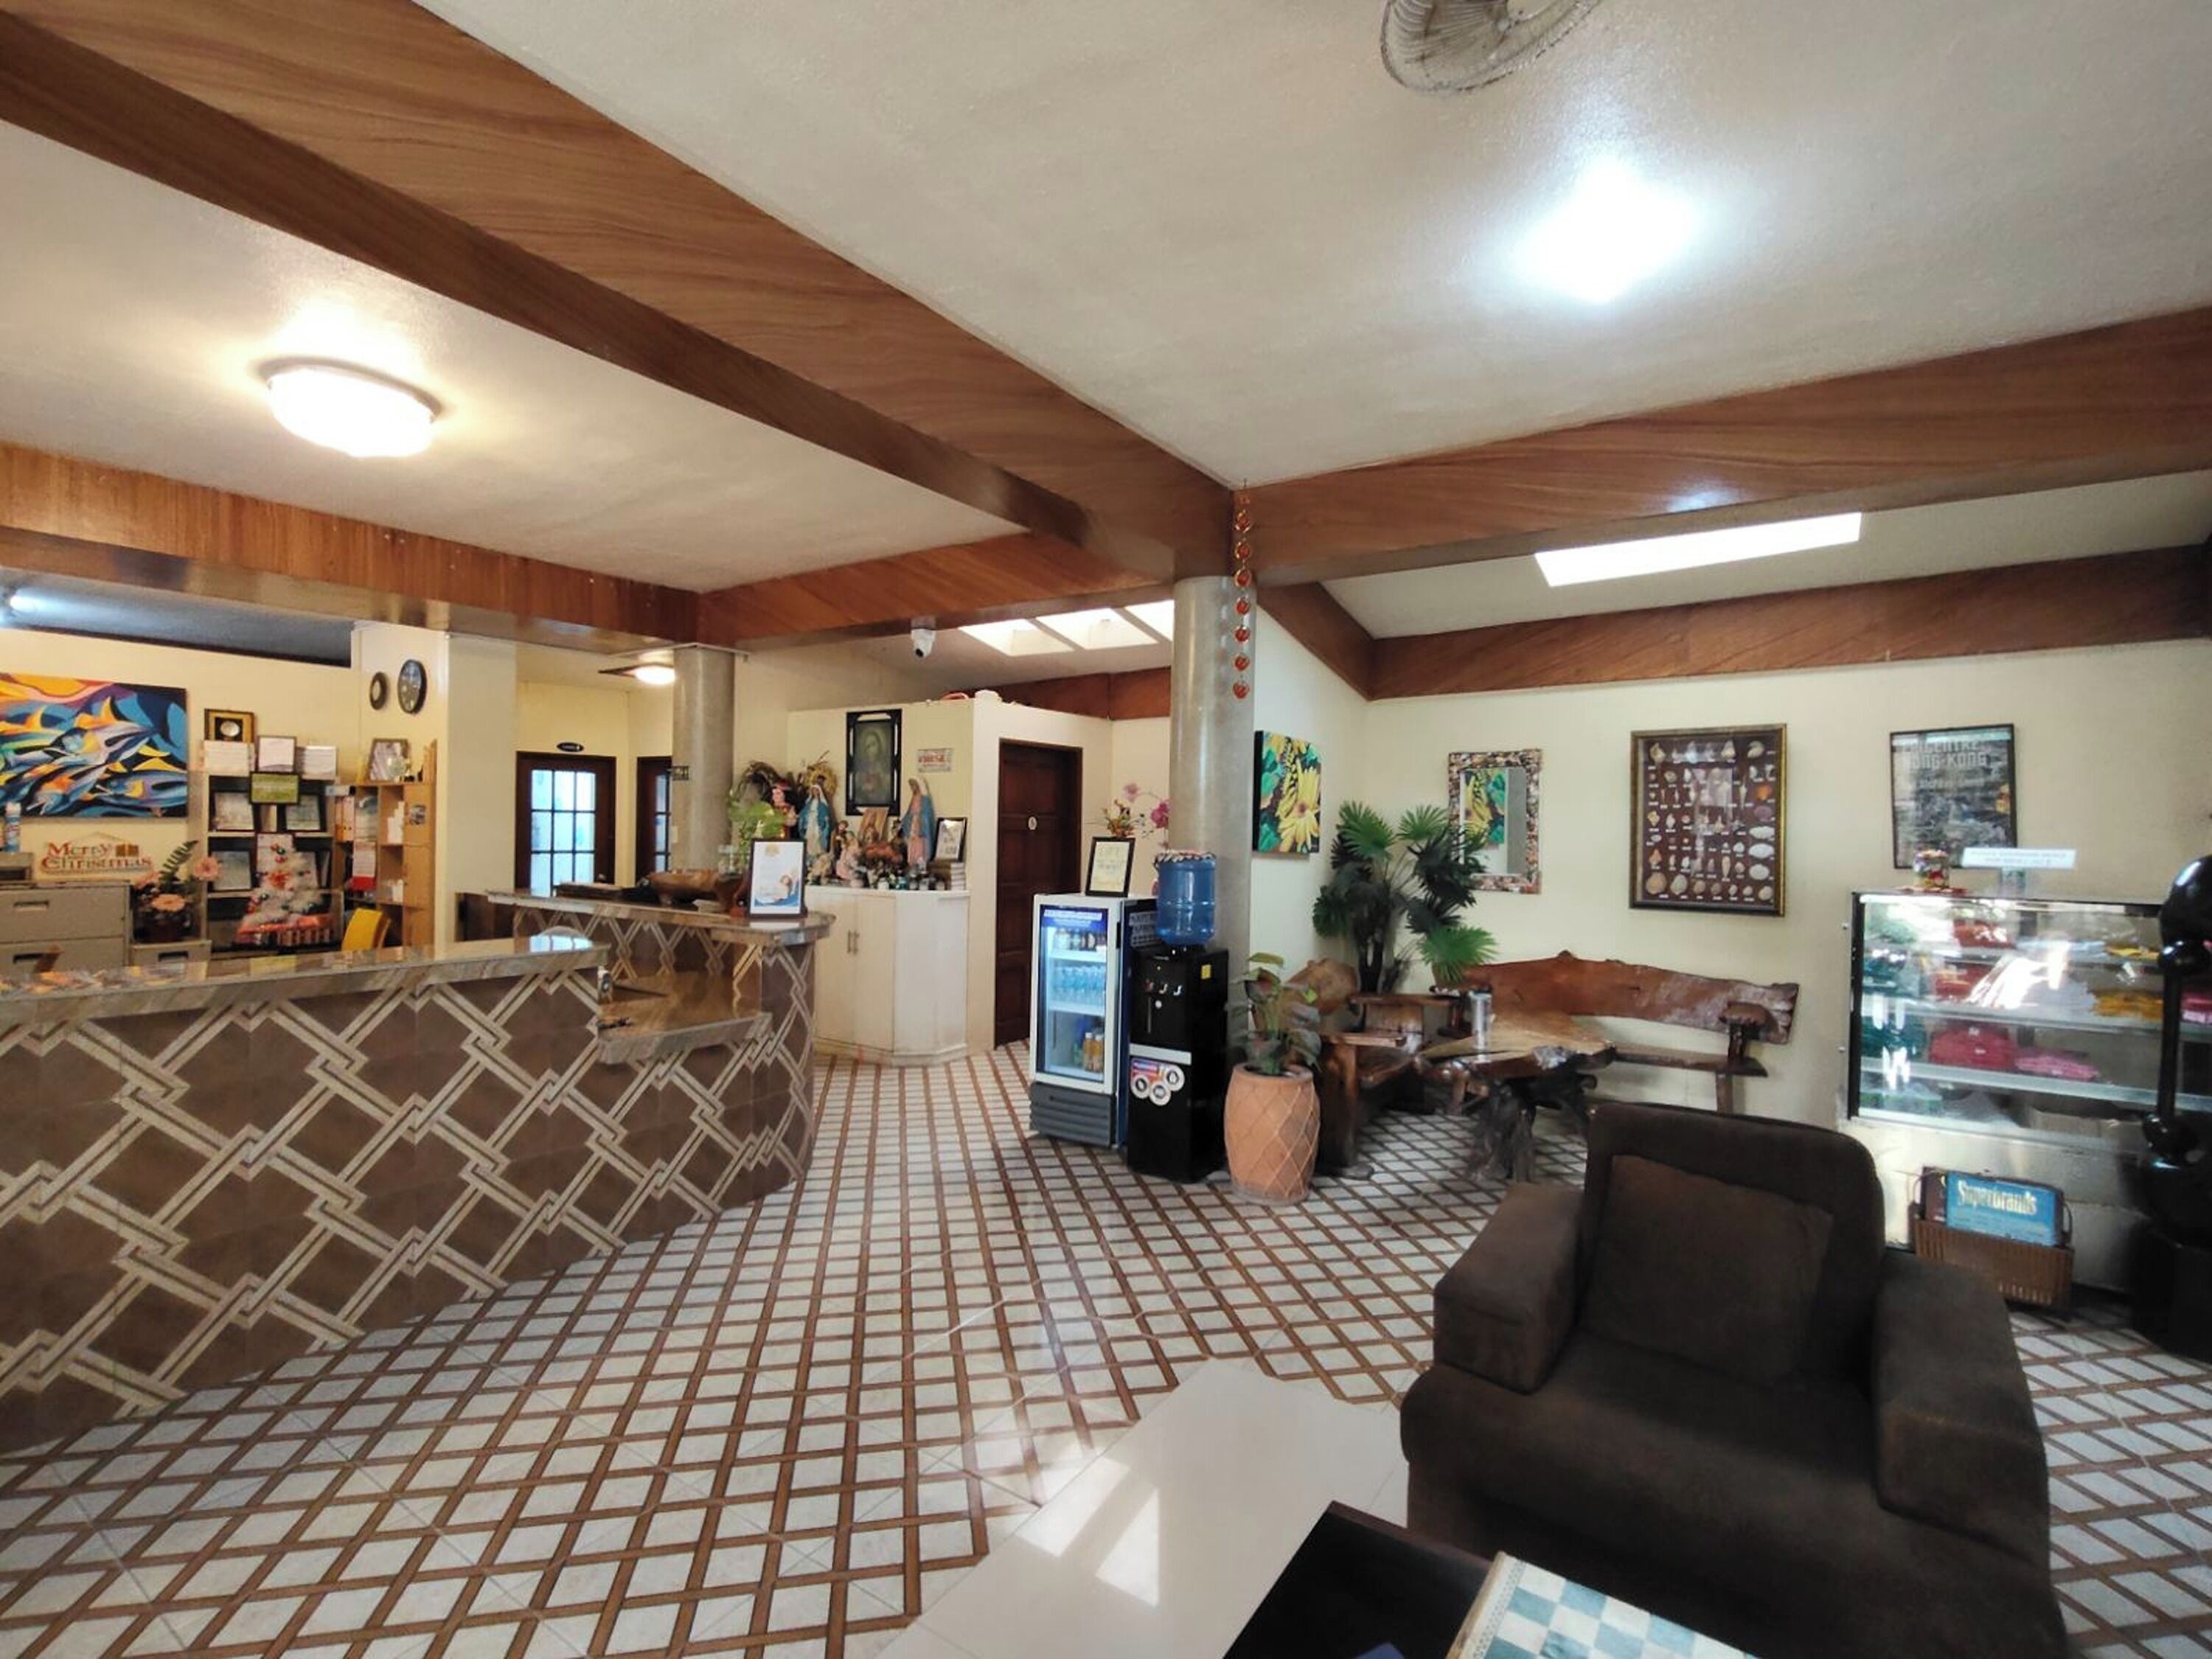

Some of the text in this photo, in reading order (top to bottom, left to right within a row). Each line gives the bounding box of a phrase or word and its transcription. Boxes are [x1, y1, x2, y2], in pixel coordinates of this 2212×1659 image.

[1905, 751, 1986, 770] ONG KONG
[46, 841, 114, 857] Merry
[41, 855, 153, 870] Christmas
[1958, 1179, 2037, 1215] Superbrands
